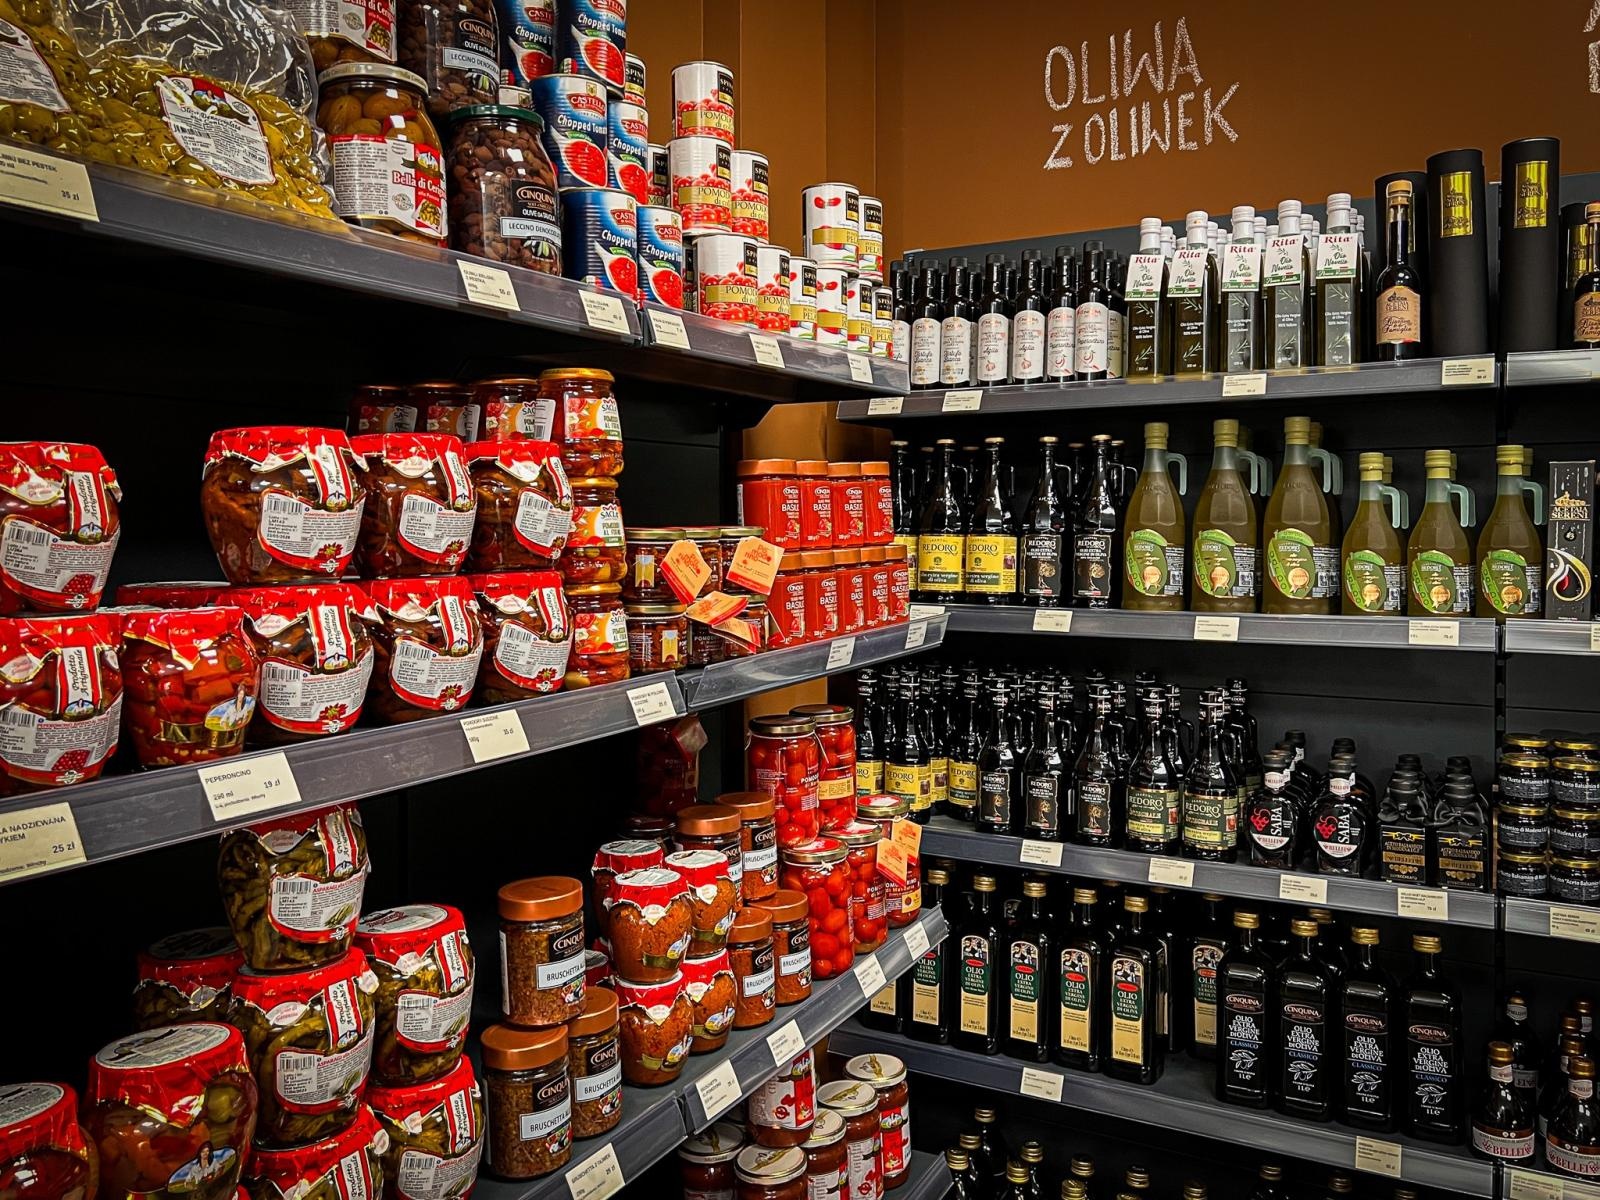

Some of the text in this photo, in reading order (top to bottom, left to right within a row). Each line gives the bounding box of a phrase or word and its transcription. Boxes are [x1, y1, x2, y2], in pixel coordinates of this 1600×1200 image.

[578, 13, 610, 31] Chopped
[515, 26, 547, 42] Chopped
[451, 53, 475, 64] LECCINO
[1044, 16, 1203, 111] OLIWA
[558, 115, 591, 131] Chopped
[1043, 81, 1240, 170] Z OLIWEK
[613, 138, 639, 154] Chopped
[392, 170, 426, 188] Bella di
[522, 209, 539, 217] OLIVE
[509, 223, 534, 231] LECCINO
[602, 229, 630, 247] Chopped
[1272, 239, 1295, 247] Rita
[646, 244, 676, 260] Chopped
[77, 478, 91, 514] Prodotto
[922, 544, 958, 556] REDORO
[1029, 541, 1056, 550] REDORO
[1078, 541, 1105, 550] REDORO
[449, 600, 461, 632] Prodotto
[326, 609, 336, 644] Prodotto
[68, 654, 79, 691] Prodotto
[205, 769, 251, 784] PEPERONCINO
[983, 776, 1005, 784] REDORO
[264, 780, 272, 788] 19
[1030, 781, 1053, 790] REDORO
[1575, 782, 1596, 790] Balsamico
[1082, 785, 1106, 794] REDORO
[1129, 796, 1164, 811] REDORO
[1186, 803, 1221, 818] REDORO
[10, 816, 66, 832] NADZIEWANA
[1270, 807, 1282, 836] SABA
[1557, 829, 1574, 837] Modena
[52, 844, 64, 853] 25
[917, 958, 936, 966] OLIO
[546, 965, 580, 982] BRUSCHETTA
[965, 966, 985, 975] OLIO
[1015, 972, 1034, 982] OLIO
[746, 976, 770, 989] BRUSCHETTA
[1065, 981, 1085, 990] OLIO
[1117, 991, 1138, 1000] OLIO
[1229, 996, 1259, 1006] CINQUINA
[1287, 1006, 1319, 1016] CINQUINA
[1232, 1020, 1256, 1028] EXTRA
[1349, 1015, 1383, 1026] CINQUINA
[1229, 1025, 1260, 1035] VERGINE
[1294, 1025, 1312, 1034] OLIO
[1412, 1026, 1447, 1037] CINQUINA
[1236, 1032, 1258, 1040] OLIVA
[1291, 1030, 1315, 1040] EXTRA
[1356, 1035, 1376, 1044] OLIO
[1230, 1040, 1258, 1049] CLASSICO
[1287, 1035, 1319, 1047] VERGINE
[1294, 1042, 1318, 1052] OLIVA
[1350, 1046, 1384, 1057] VERGINE
[1354, 1042, 1379, 1051] EXTRA
[1420, 1047, 1440, 1056] OLIO
[1289, 1051, 1318, 1060] CLASSICO
[1358, 1053, 1382, 1063] OLIVA
[1418, 1053, 1443, 1062] EXTRA
[316, 1055, 343, 1068] ASPARAGI
[1413, 1058, 1448, 1068] VERGINE
[1352, 1062, 1382, 1072] CLASSICO
[1422, 1065, 1447, 1074] OLIVA
[1415, 1074, 1448, 1083] CLASSICO
[584, 1079, 615, 1095] BRUSCHETTA
[530, 1114, 565, 1132] BRUSCHETTA
[1493, 1146, 1526, 1156] BELLEI
[1555, 1157, 1589, 1174] BELLEI
